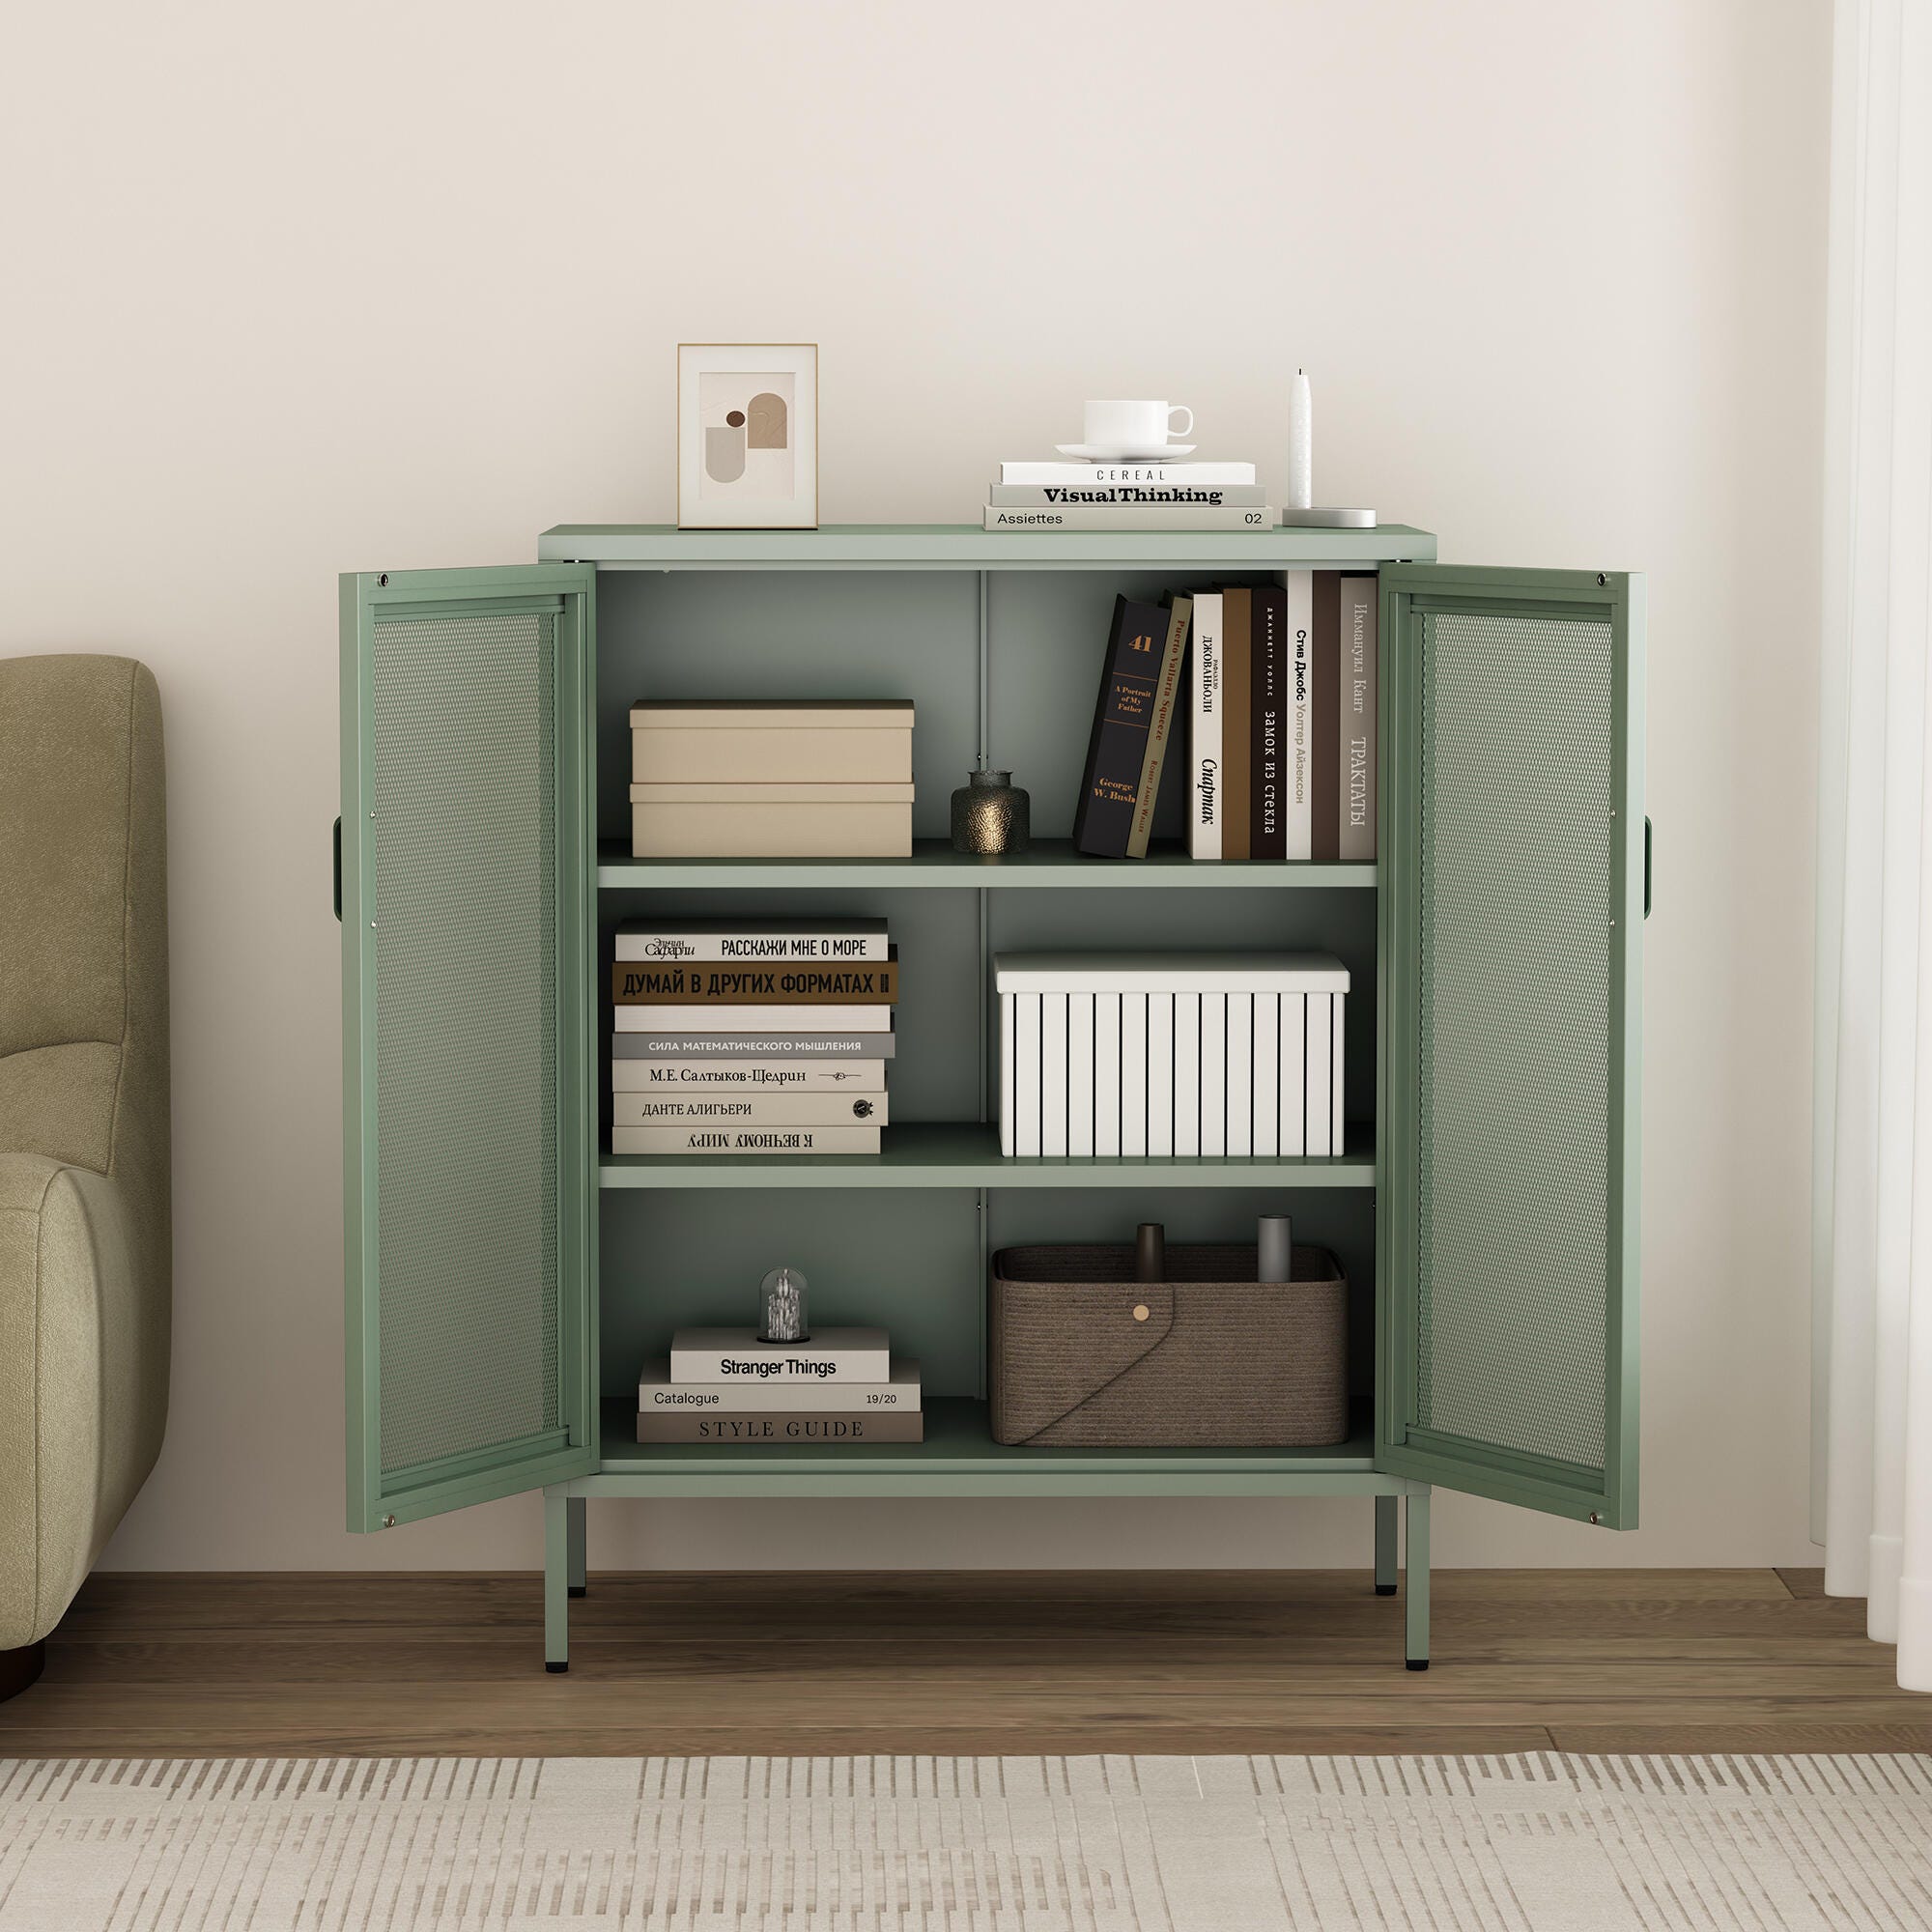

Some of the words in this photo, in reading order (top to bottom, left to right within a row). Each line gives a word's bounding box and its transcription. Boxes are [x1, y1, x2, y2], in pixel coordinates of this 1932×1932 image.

[1096, 469, 1165, 481] CEREAL
[997, 513, 1064, 525] Assiettes
[1244, 513, 1263, 525] 02
[1128, 635, 1151, 653] 41
[1172, 619, 1185, 653] Puerto
[1296, 629, 1307, 659] Стив
[1350, 603, 1368, 673] Иммануил
[1164, 657, 1179, 696] Vallarta
[1201, 635, 1214, 714] ДЖОВАНЬОЛИ
[1294, 661, 1307, 701] Джобс
[1122, 686, 1151, 698] Portrait
[1353, 679, 1367, 714] Кант
[1118, 702, 1143, 714] Father
[1129, 697, 1141, 706] My
[1156, 699, 1170, 741] Squeeze
[1294, 702, 1307, 746] Уолтер
[1099, 778, 1133, 791] George
[1295, 748, 1307, 805] Айзексон
[1350, 736, 1367, 827] ТРАКТАТЫ
[1094, 787, 1107, 798] W.
[1110, 790, 1137, 804] Bush
[1196, 758, 1218, 825] Спартак
[722, 939, 787, 956] РАССКАЖИ
[790, 939, 817, 956] МНЕ
[821, 939, 830, 956] О
[833, 939, 867, 956] МОРЕ
[622, 969, 684, 997] ДУМАЙ
[691, 973, 701, 994] В
[706, 973, 776, 997] ДРУГИХ
[781, 973, 874, 994] ФОРМАТАХ
[648, 1041, 680, 1051] СИЛА
[683, 1041, 793, 1051] МАТЕМАТИЧЕСКОГО
[795, 1041, 862, 1051] МЫШЛЕНИЯ
[649, 1068, 678, 1082] М.Е.
[680, 1068, 806, 1086] Салтыков-Щедрин
[641, 1103, 684, 1118] ДАНТЕ
[686, 1103, 752, 1116] АЛИГЬЕРИ
[687, 1133, 729, 1148] МИРУ
[734, 1133, 801, 1148] ВЕЧНОМУ
[803, 1134, 813, 1148] К
[721, 1358, 783, 1378] Stranger
[784, 1358, 837, 1378] Things
[654, 1392, 720, 1406] Catalogue
[866, 1393, 897, 1405] 19/20
[699, 1421, 774, 1437] STYLE
[786, 1421, 863, 1437] GUIDE
